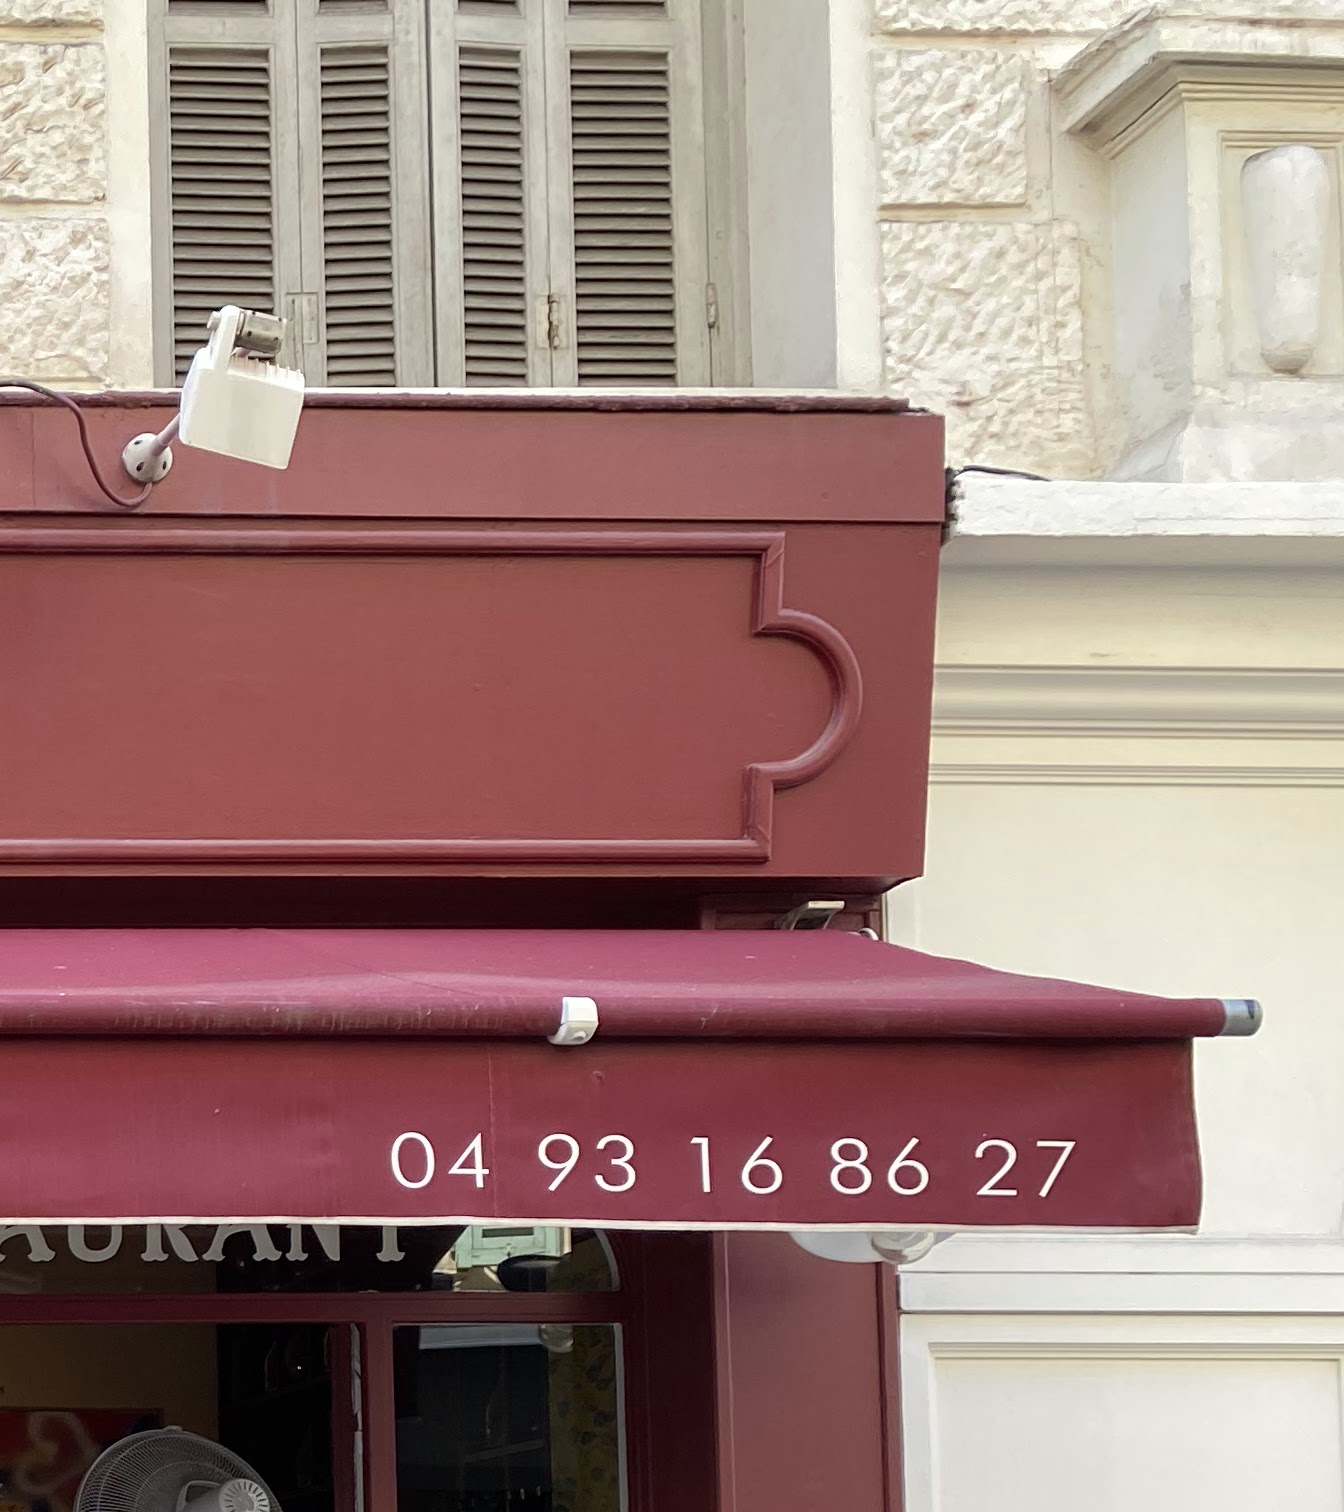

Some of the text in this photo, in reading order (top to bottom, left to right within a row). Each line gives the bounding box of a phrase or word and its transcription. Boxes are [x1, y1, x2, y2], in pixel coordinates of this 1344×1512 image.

[391, 1132, 1077, 1198] 04 93 16 86 27
